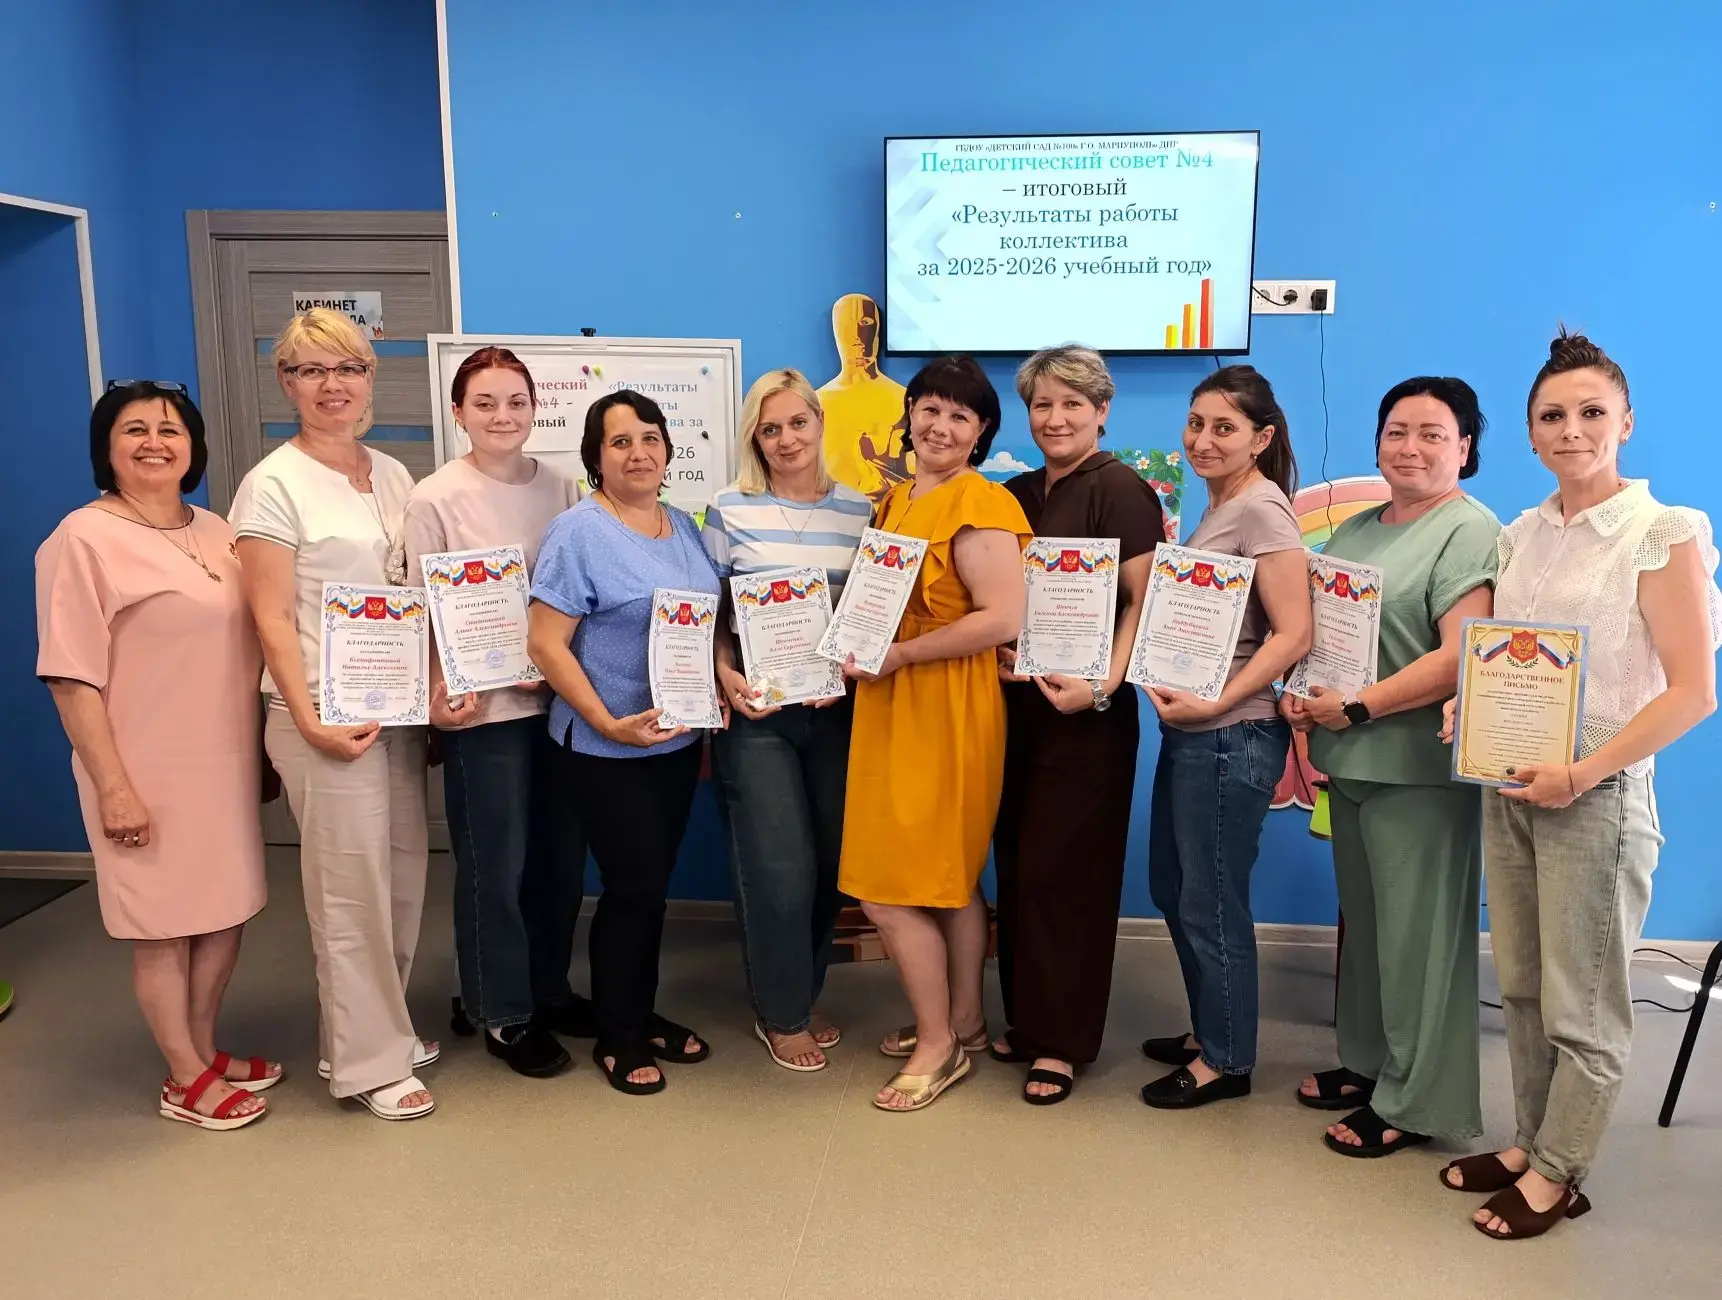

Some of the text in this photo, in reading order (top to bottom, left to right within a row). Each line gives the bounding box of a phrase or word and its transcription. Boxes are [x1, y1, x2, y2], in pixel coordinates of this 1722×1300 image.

[1033, 142, 1052, 151] САД
[920, 148, 1214, 174] Педагогический совет №4
[1023, 178, 1128, 197] итоговый
[951, 202, 1180, 227] «Результаты работы
[999, 234, 1129, 250] коллектива
[917, 256, 1213, 279] за 2025-2026 учебный год»
[296, 299, 357, 311] КАБИНЕТ
[533, 378, 588, 390] ческий
[608, 381, 698, 394] «Результаты
[689, 418, 703, 427] за
[678, 470, 705, 482] год
[1480, 669, 1565, 685] БЛАГОДАРСТВЕННОЕ
[1503, 681, 1539, 690] ПИСЬМО
